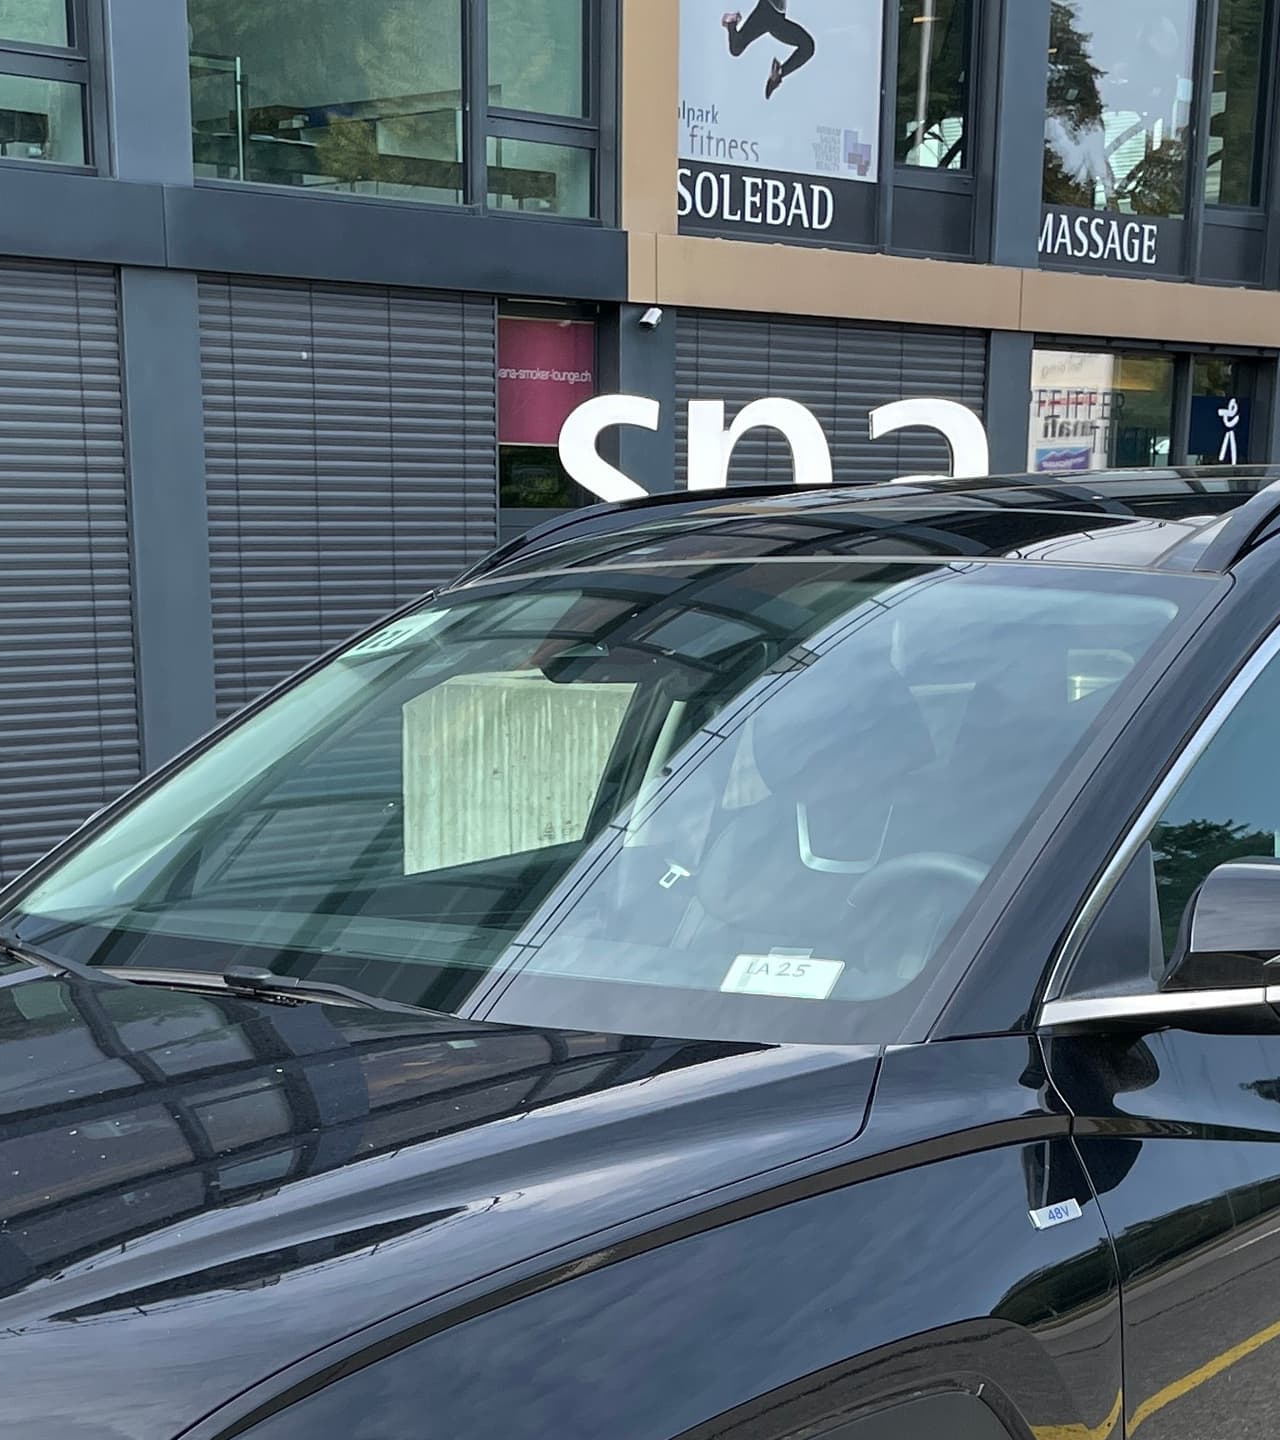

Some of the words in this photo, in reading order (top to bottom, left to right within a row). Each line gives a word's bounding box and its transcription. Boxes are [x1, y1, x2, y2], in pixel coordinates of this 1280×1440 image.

[678, 100, 719, 128] lpark
[689, 125, 761, 162] fitness
[677, 168, 834, 230] SOLEBAD
[1048, 1205, 1069, 1221] 48V
